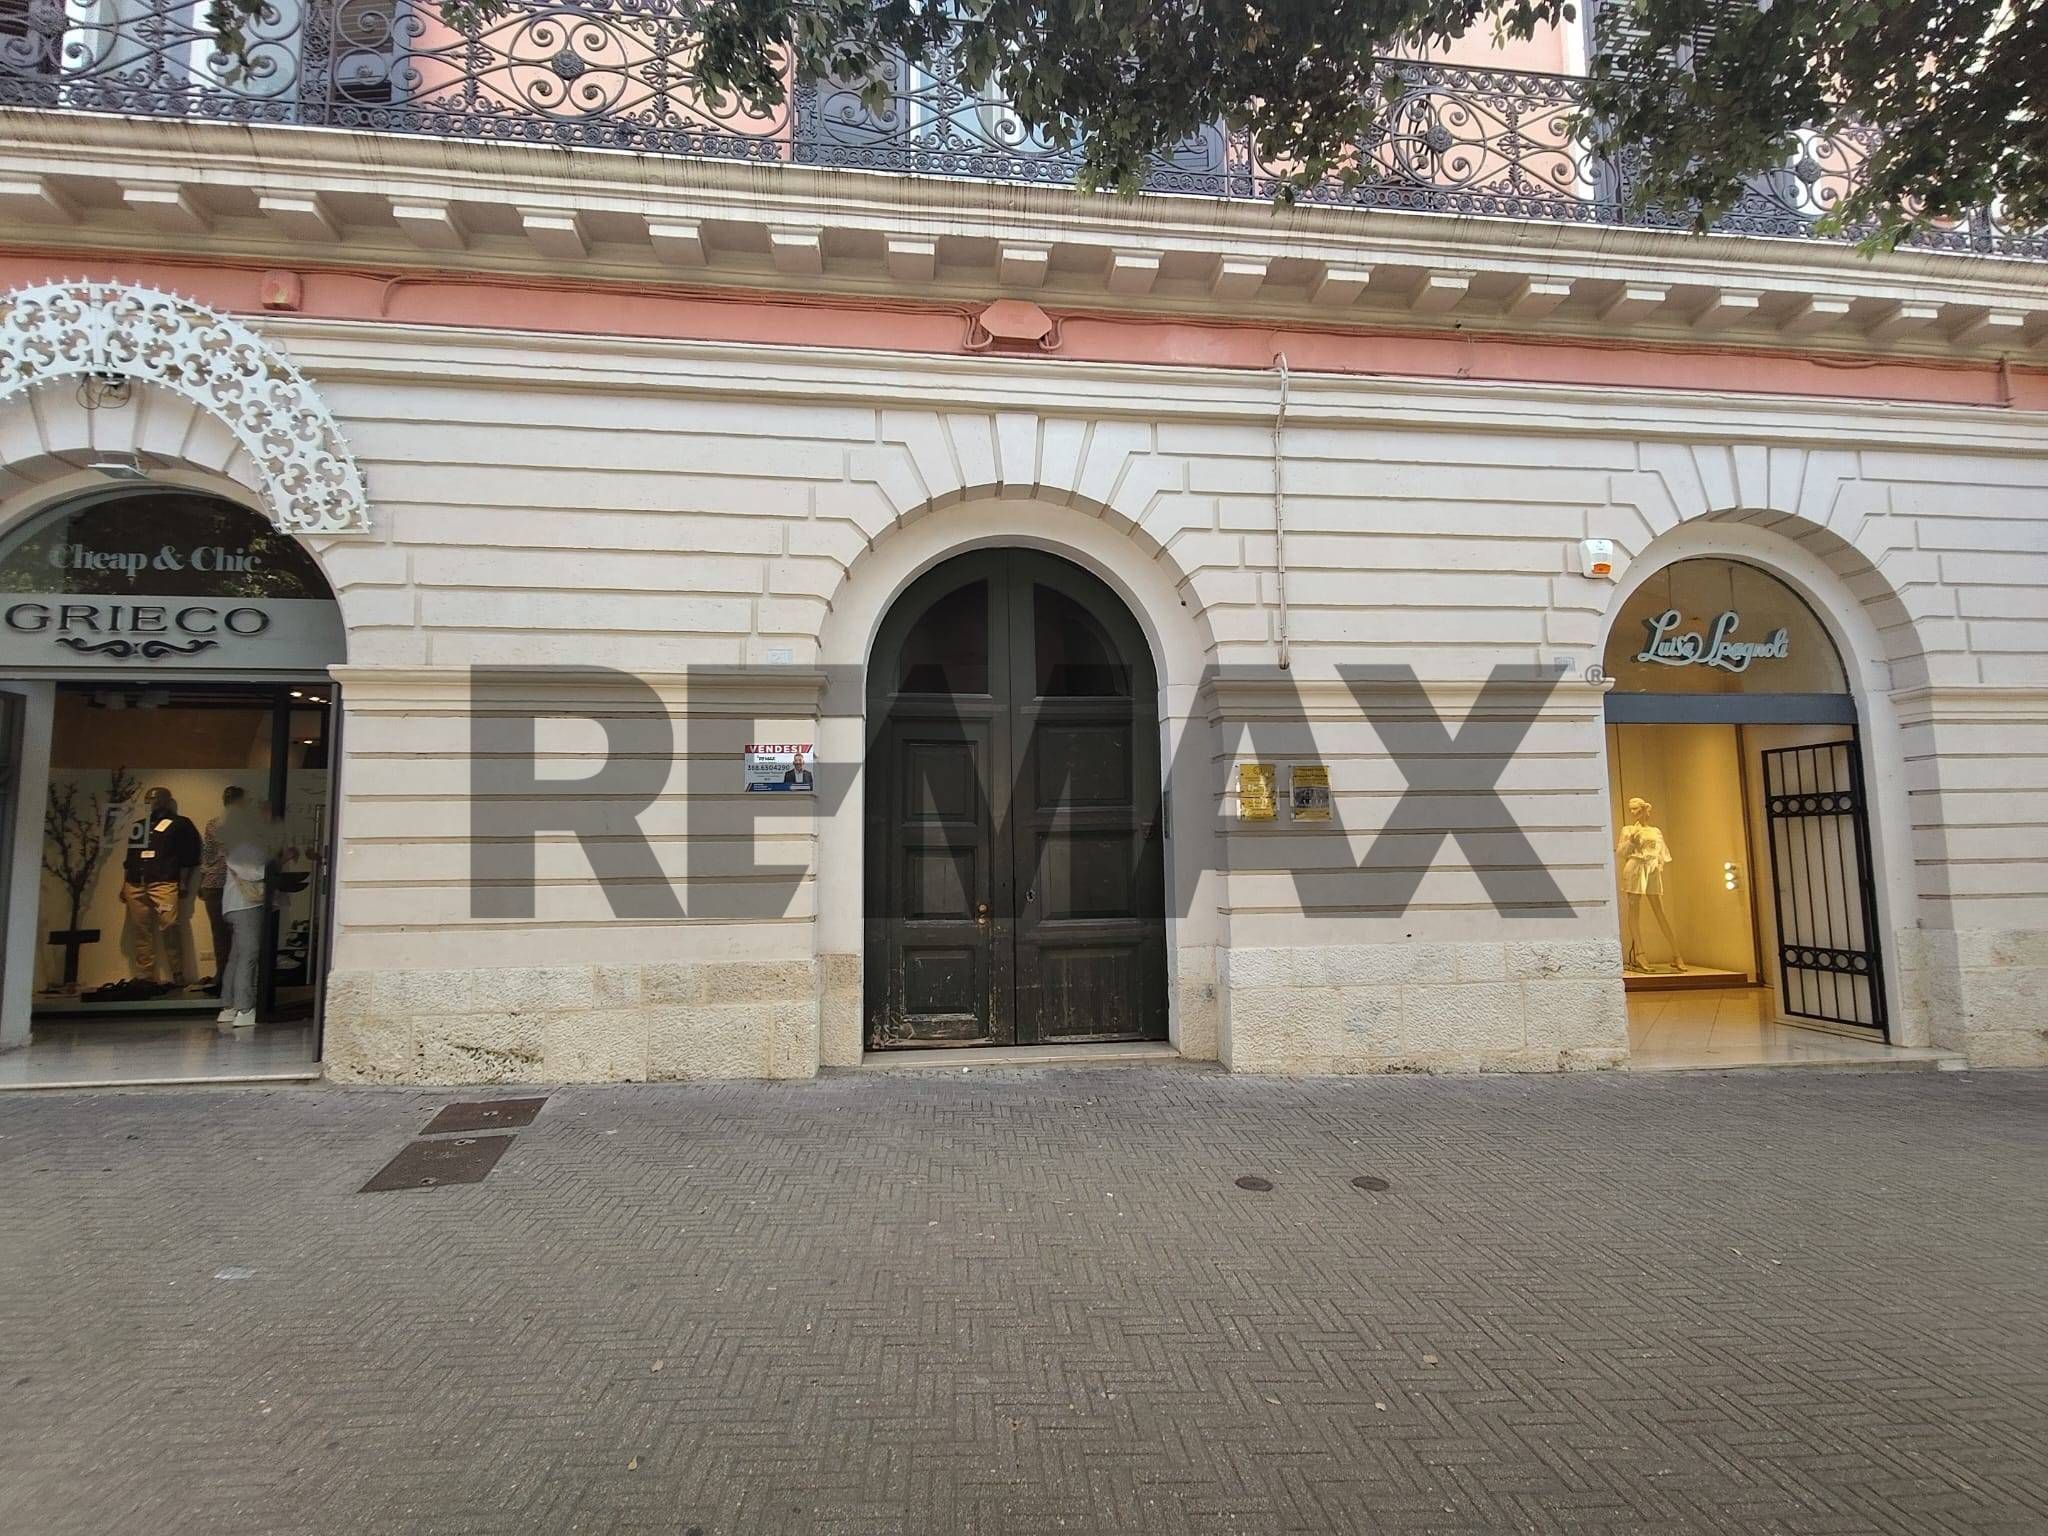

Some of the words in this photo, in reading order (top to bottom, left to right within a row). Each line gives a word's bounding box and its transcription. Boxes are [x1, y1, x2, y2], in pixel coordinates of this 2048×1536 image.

[51, 543, 148, 577] Cheap
[152, 545, 185, 571] &
[190, 546, 262, 573] Chic
[5, 603, 271, 636] GRIECO
[750, 745, 802, 753] VENDESI
